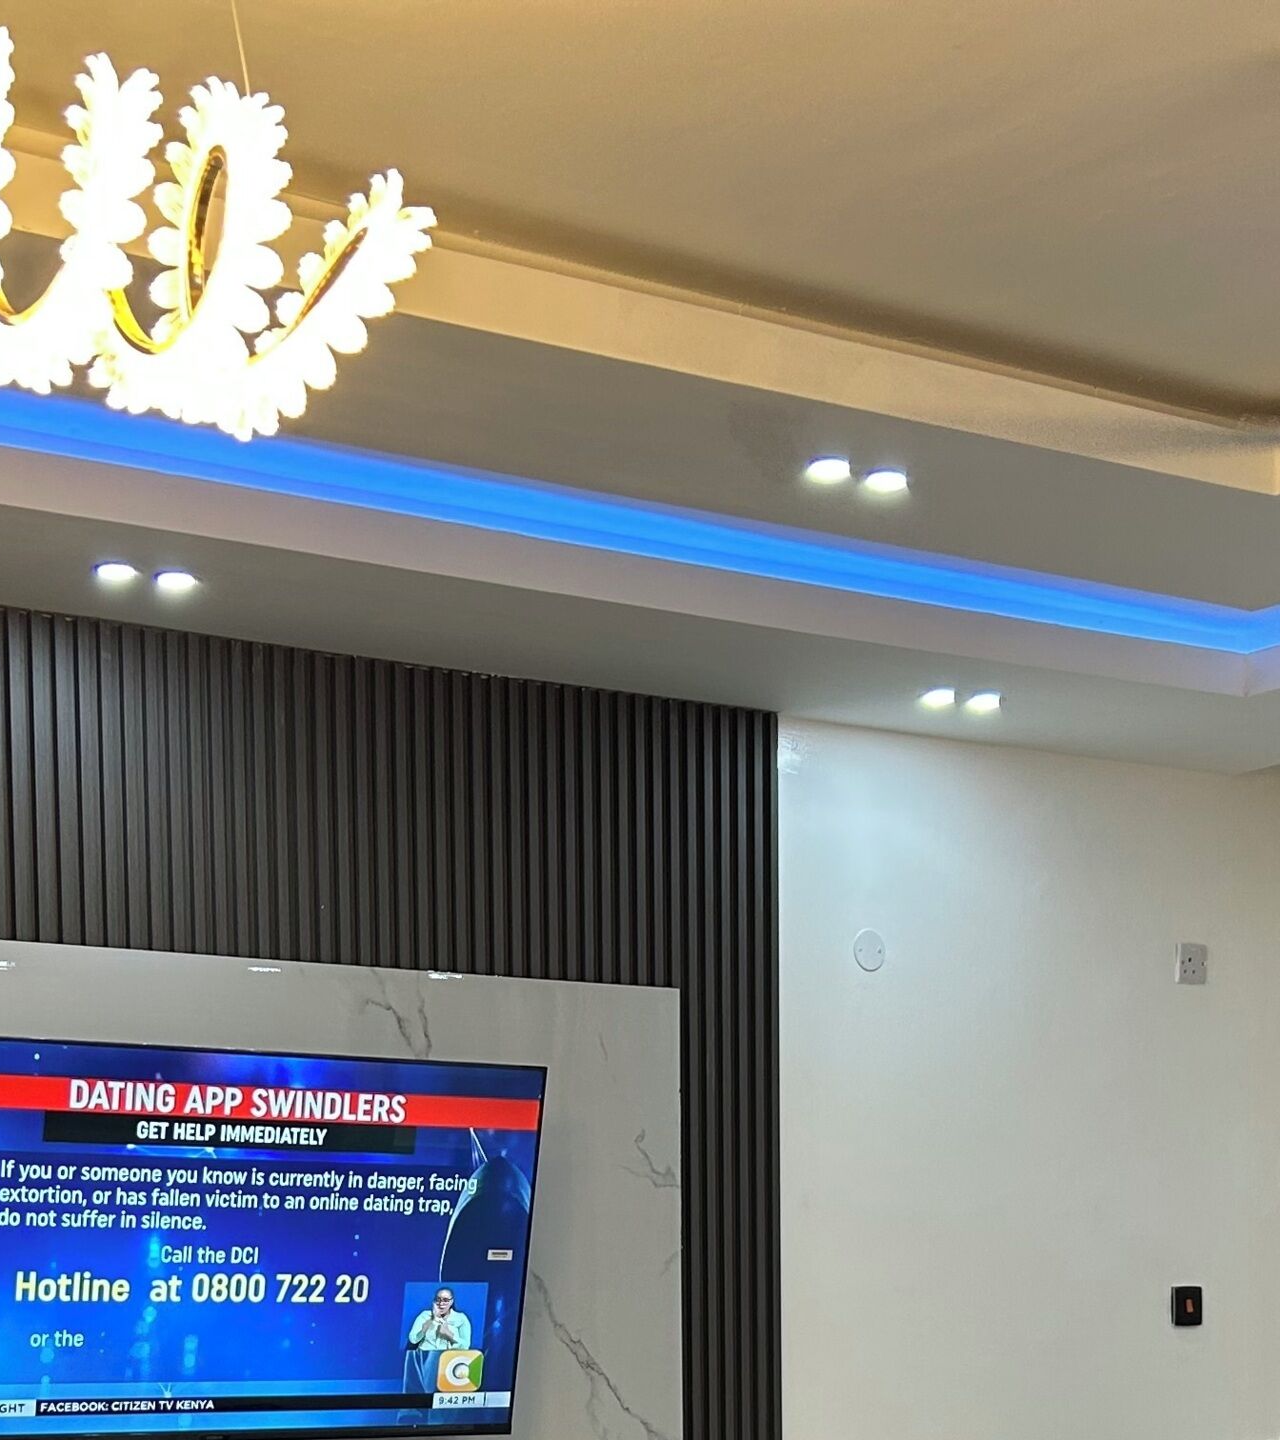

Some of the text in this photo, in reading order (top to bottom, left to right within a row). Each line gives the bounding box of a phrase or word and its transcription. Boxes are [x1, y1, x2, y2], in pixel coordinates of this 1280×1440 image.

[70, 1078, 407, 1123] DATING APP SWINDLERS
[136, 1121, 328, 1146] GET HELP IMMEDIATELY
[0, 1159, 478, 1194] If you or someone you know is currently in danger, facing
[92, 1190, 112, 1205] or
[115, 1187, 147, 1206] has
[151, 1188, 200, 1207] fallen
[205, 1189, 258, 1209] victim
[262, 1192, 280, 1209] to
[284, 1195, 305, 1210] an
[309, 1193, 359, 1211] online
[363, 1194, 414, 1215] dating
[419, 1197, 453, 1216] trap,
[26, 1210, 57, 1227] not
[61, 1209, 116, 1228] suffer
[120, 1210, 137, 1228] in
[140, 1211, 207, 1230] silence.
[160, 1245, 259, 1264] Call the DCI
[15, 1271, 369, 1303] Hotline at 0800 722 20
[30, 1330, 85, 1348] or the
[40, 1400, 215, 1412] FACEBOOK: CITIZEN TV KENYA
[439, 1396, 476, 1404] 9:42 PM
